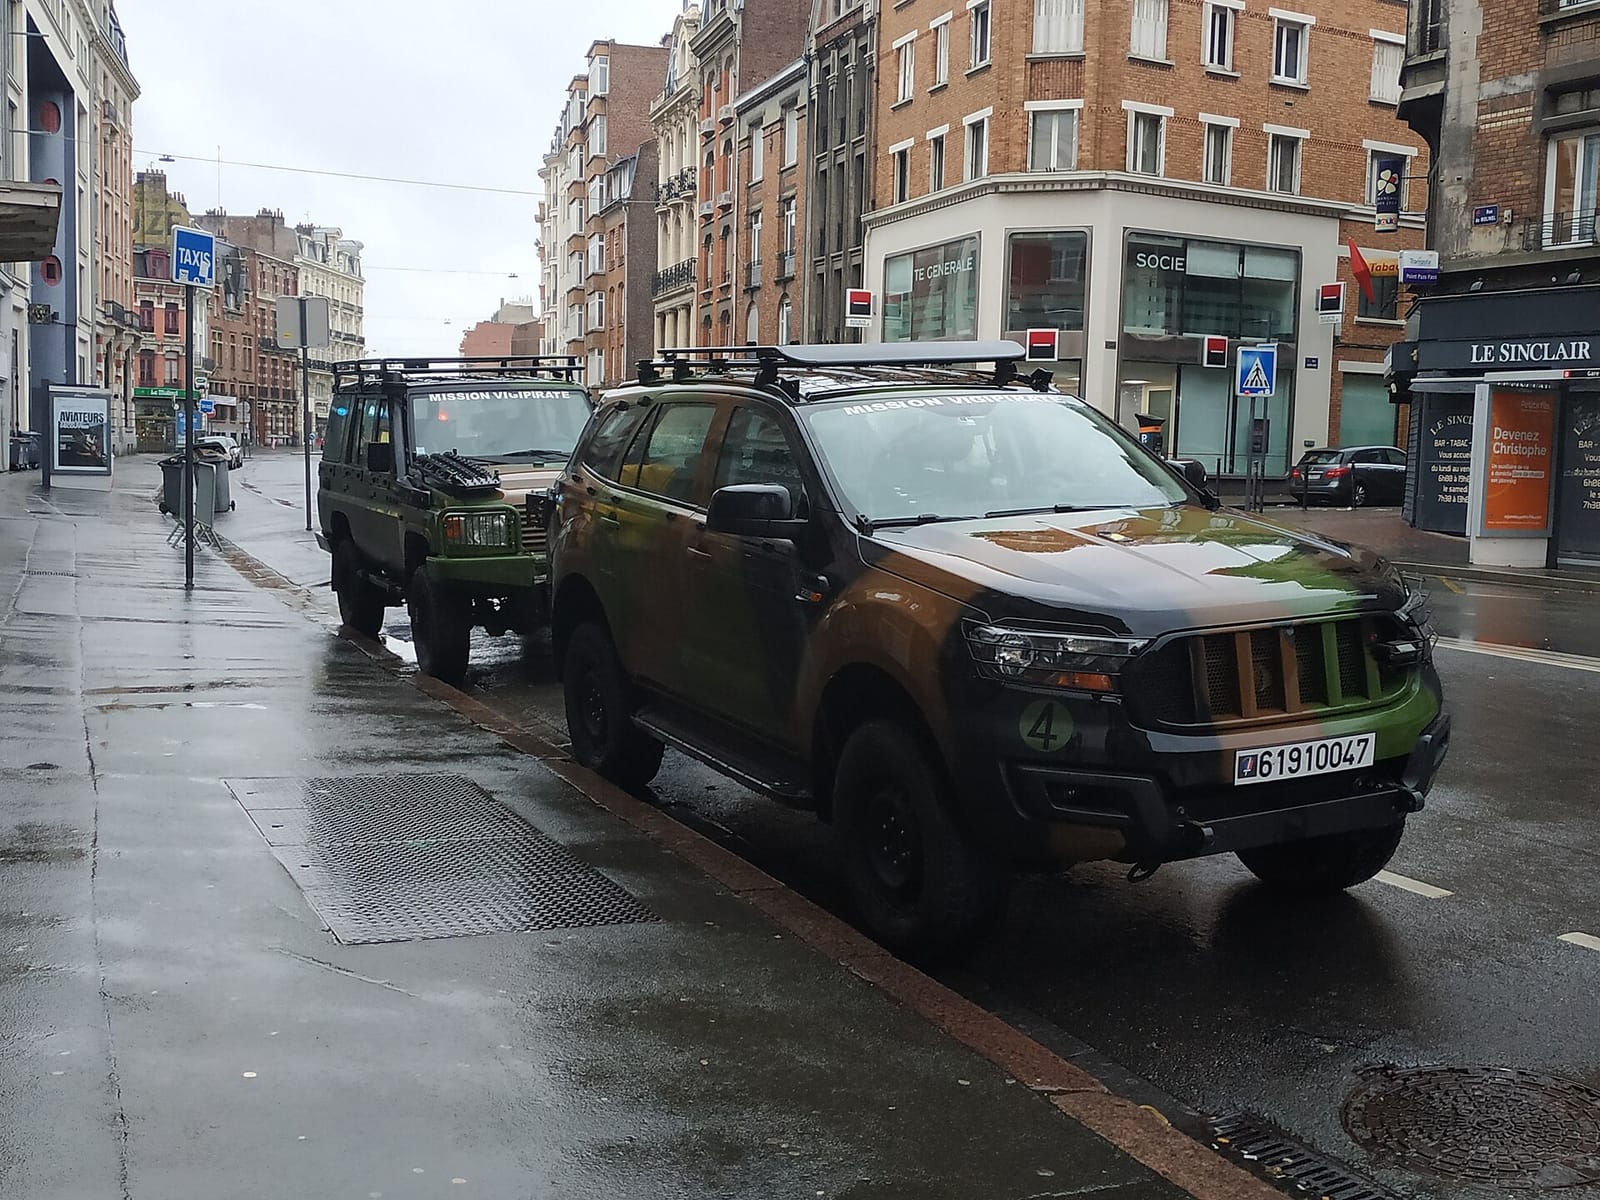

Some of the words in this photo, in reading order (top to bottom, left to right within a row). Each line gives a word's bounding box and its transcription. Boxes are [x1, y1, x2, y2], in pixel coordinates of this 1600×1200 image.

[178, 248, 210, 268] TAXIS
[1136, 253, 1184, 271] SOCIE
[914, 268, 924, 281] TE
[926, 256, 974, 280] GENERALE
[1470, 344, 1494, 362] LE
[1499, 342, 1591, 362] SINCLAIR
[429, 391, 490, 402] MISSION
[492, 390, 570, 400] VIGIPIRATE
[844, 397, 944, 416] MISSION
[1494, 427, 1540, 440] Devenez
[1492, 442, 1546, 457] Christophe
[1578, 440, 1593, 448] BAR
[1028, 702, 1058, 750] 4
[1258, 738, 1370, 777] 61910047
